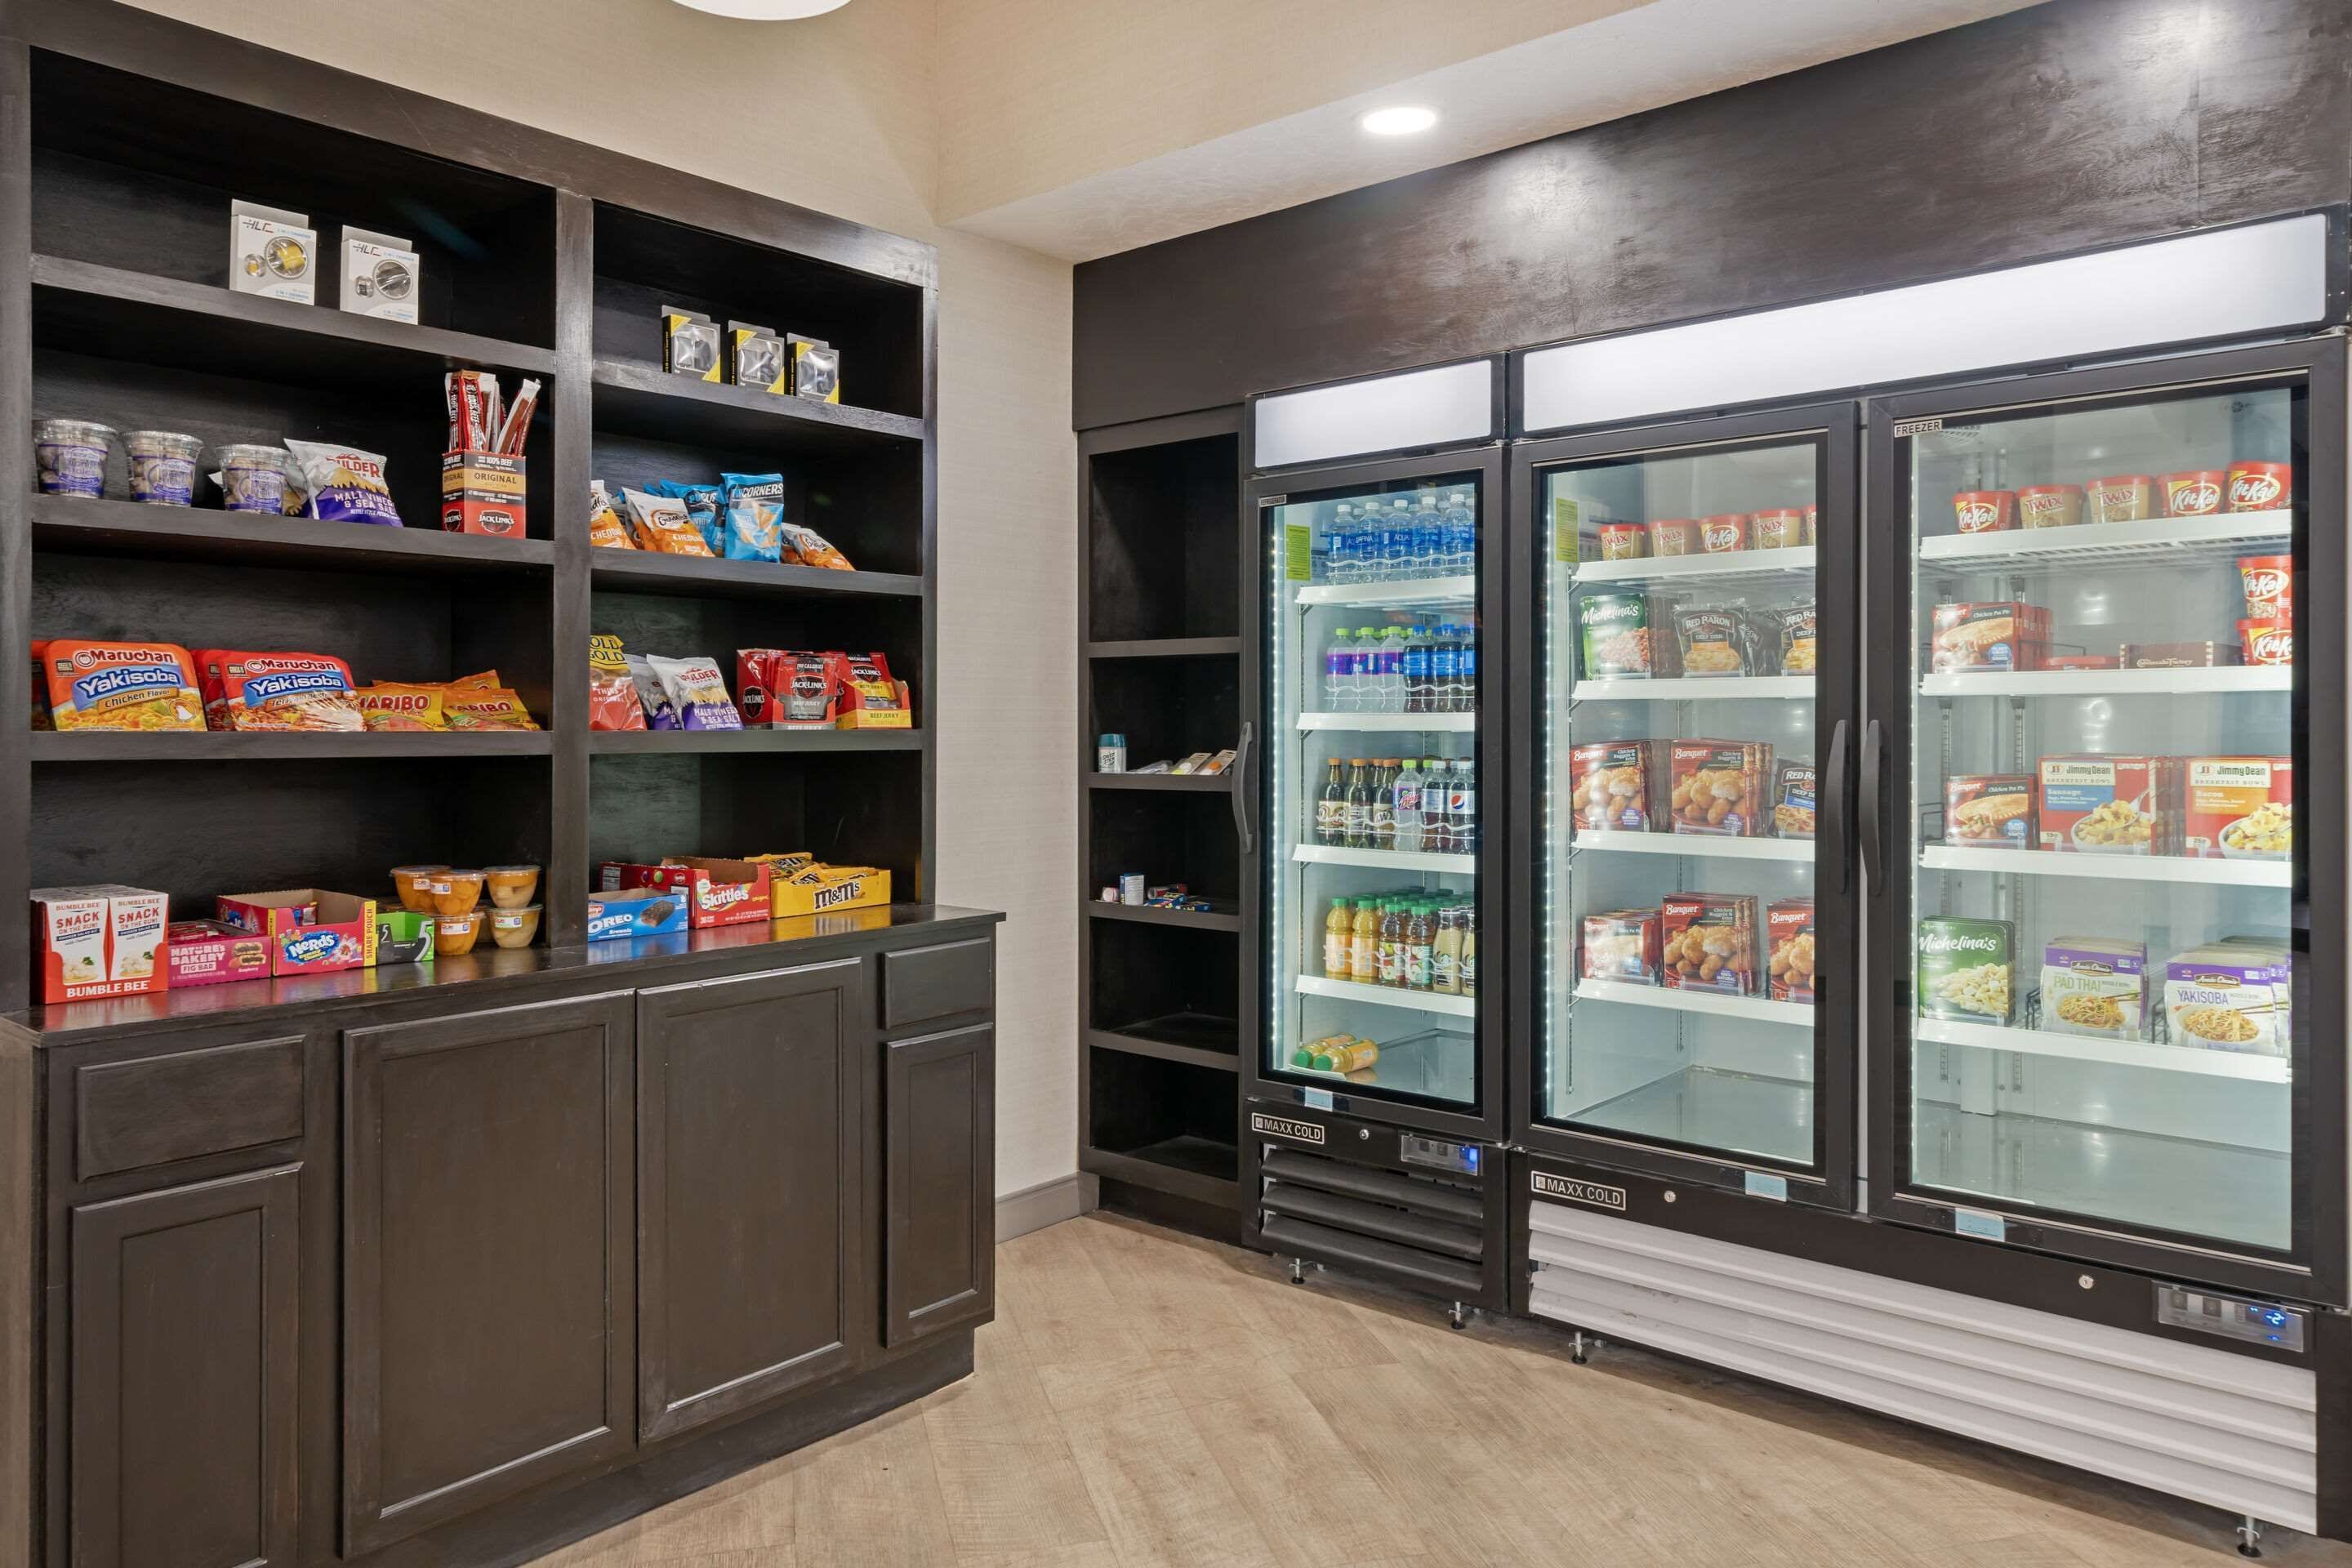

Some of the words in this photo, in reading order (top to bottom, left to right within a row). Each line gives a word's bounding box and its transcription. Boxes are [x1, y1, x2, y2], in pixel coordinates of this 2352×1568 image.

[1895, 422, 1941, 435] FREEZER
[501, 458, 514, 466] BEEF
[474, 472, 517, 484] ORIGINAL
[334, 491, 363, 502] MALT
[355, 499, 376, 509] SEA
[1686, 618, 1700, 628] RED
[1786, 615, 1803, 626] RED
[90, 650, 174, 664] Maruchan
[261, 659, 337, 670] Maruchan
[80, 669, 178, 697] Yakisoba
[252, 675, 341, 695] Yakisoba
[105, 692, 145, 708] Chicken
[147, 688, 171, 698] Flavor
[1786, 771, 1803, 780] RED
[2066, 765, 2091, 775] Jimmy
[2092, 765, 2110, 774] Dean
[2217, 765, 2245, 777] Jimmy
[2246, 766, 2266, 776] Dean
[702, 888, 749, 910] Skittles
[56, 911, 100, 929] SNACK
[118, 907, 159, 924] SNACK
[588, 914, 633, 933] OREO
[171, 952, 225, 965] BAKERY
[183, 964, 196, 973] FIG
[66, 982, 122, 998] BUMBLE
[123, 980, 149, 992] BEE
[2053, 976, 2074, 989] PAD
[2076, 978, 2100, 992] THAI
[2177, 990, 2230, 1005] YAKISOBA
[1264, 1119, 1293, 1135] MAXX
[1294, 1125, 1321, 1141] COLD
[1546, 1178, 1584, 1198] MAXX
[1587, 1187, 1621, 1205] COLD
